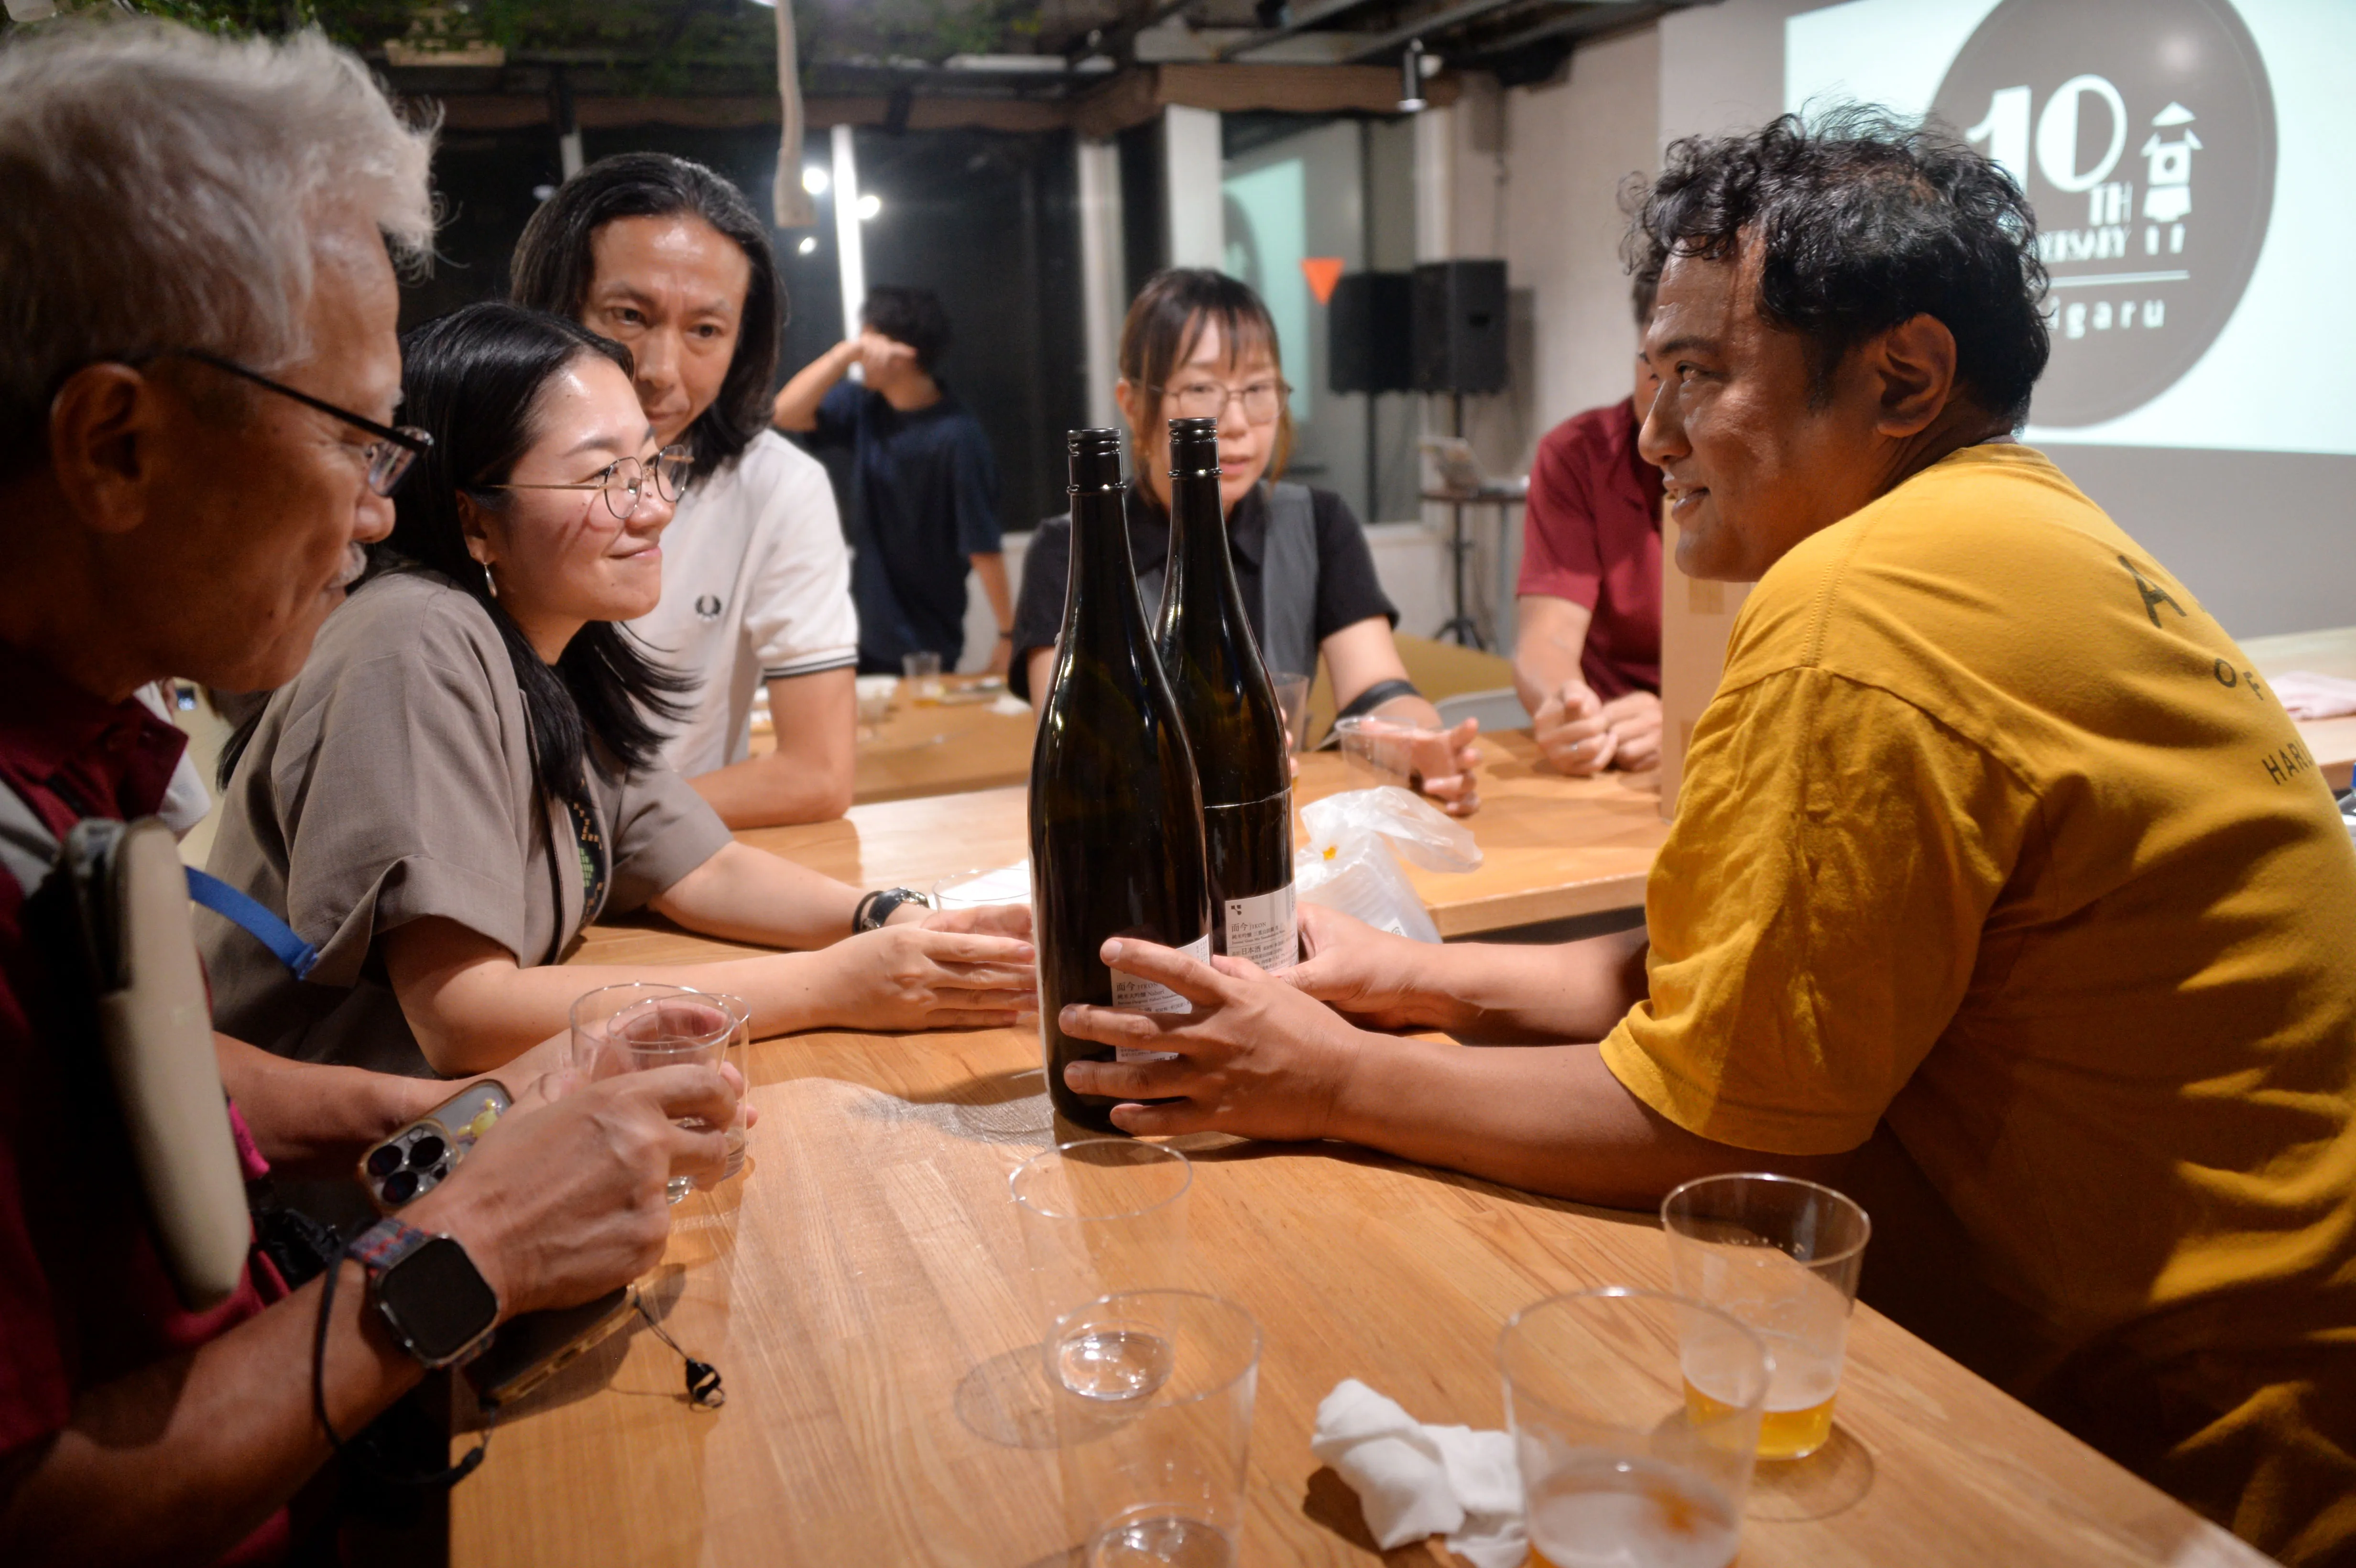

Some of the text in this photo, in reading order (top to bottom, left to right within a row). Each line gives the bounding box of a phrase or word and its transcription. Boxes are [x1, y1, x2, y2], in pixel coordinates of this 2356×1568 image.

[1965, 74, 2127, 192] 10
[2089, 181, 2133, 226] TH
[2214, 658, 2264, 701] OF
